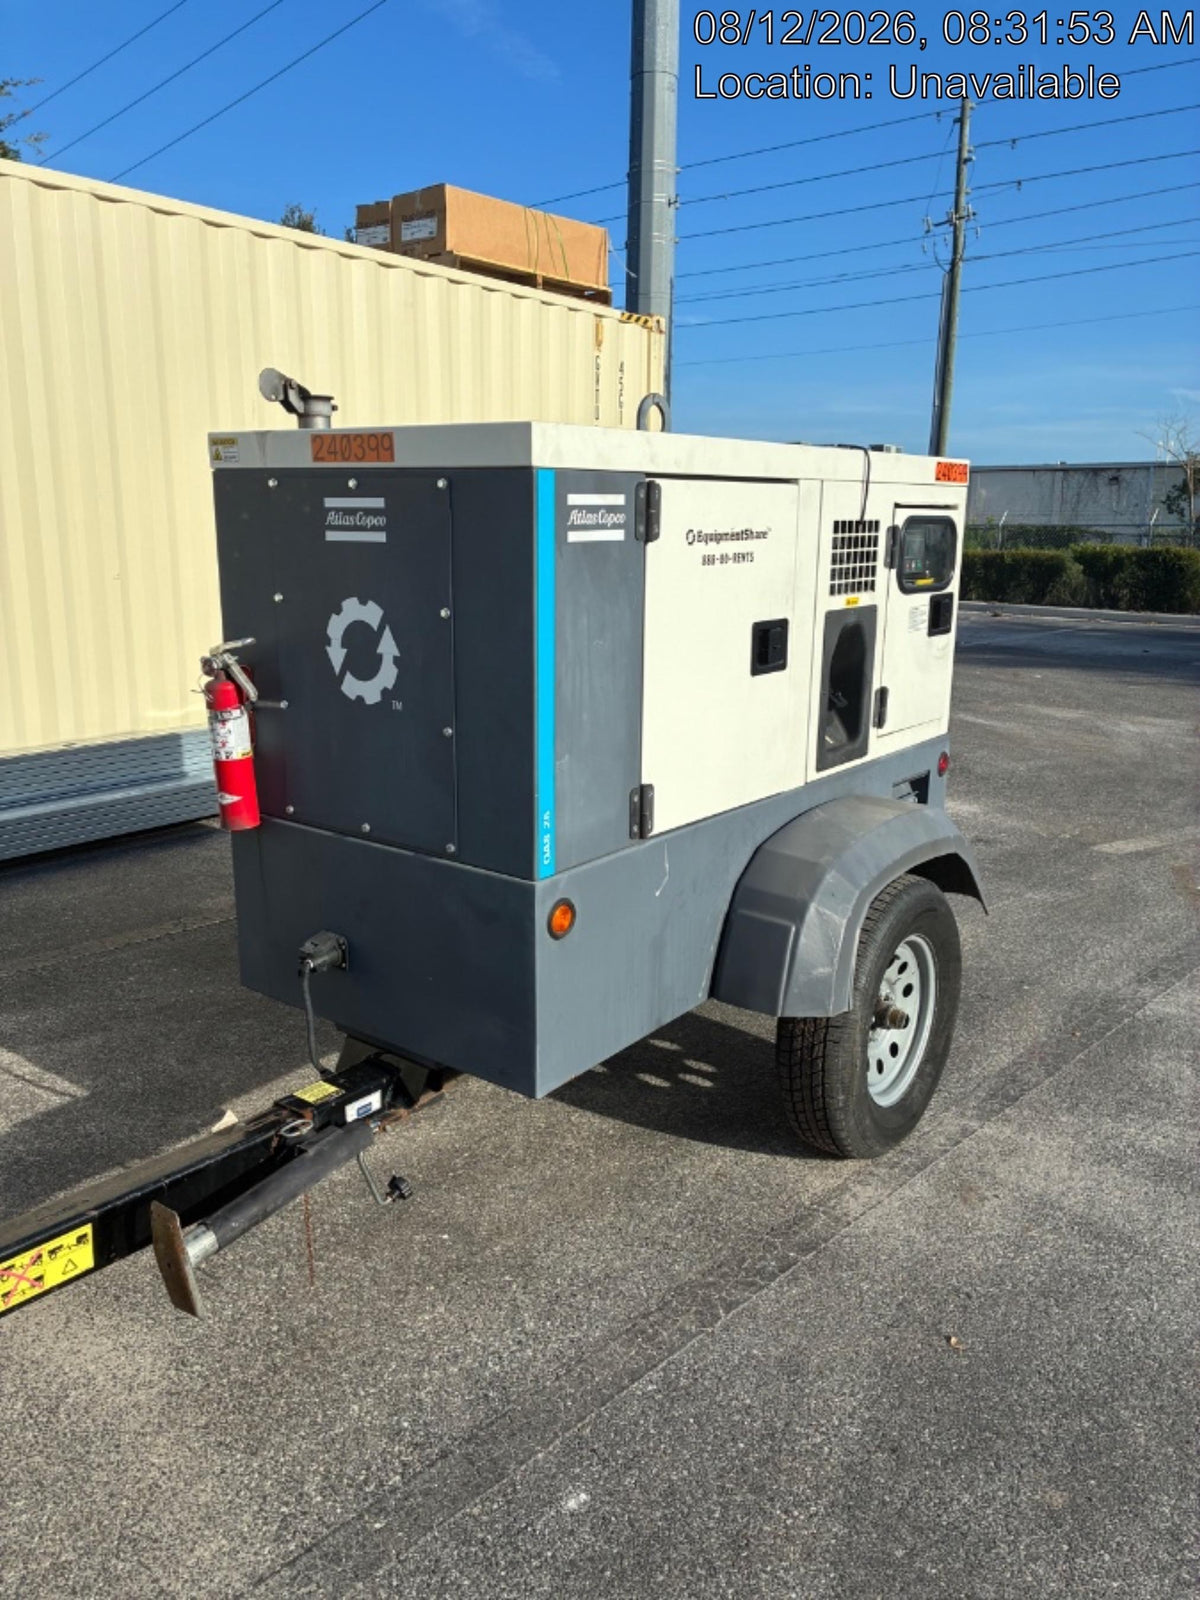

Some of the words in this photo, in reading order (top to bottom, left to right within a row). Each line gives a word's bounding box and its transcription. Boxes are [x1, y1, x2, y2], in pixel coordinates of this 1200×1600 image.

[312, 433, 394, 462] 240399
[325, 510, 355, 527] Atlas
[355, 511, 387, 529] Copco
[567, 509, 598, 525] Atlas
[598, 508, 626, 527] Copco
[696, 527, 768, 546] EquipmentShare
[702, 551, 754, 566] 888-80-RENTS
